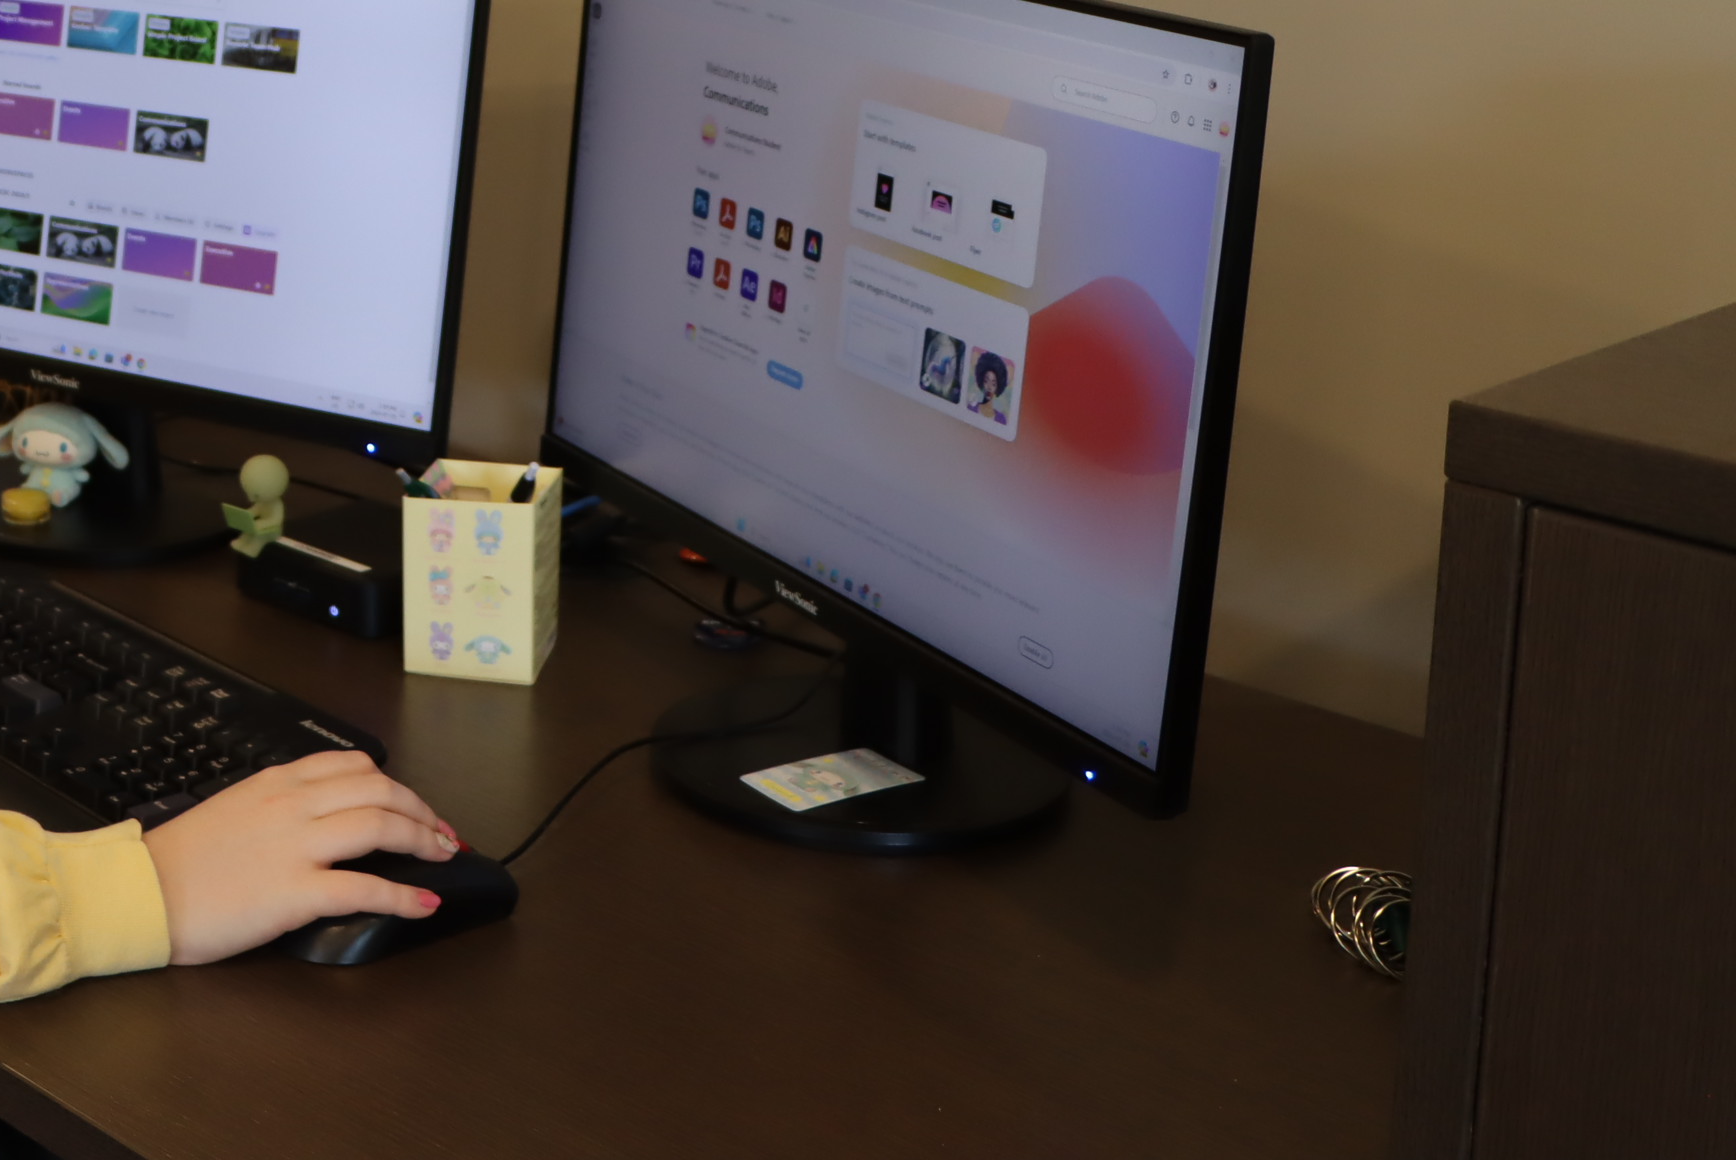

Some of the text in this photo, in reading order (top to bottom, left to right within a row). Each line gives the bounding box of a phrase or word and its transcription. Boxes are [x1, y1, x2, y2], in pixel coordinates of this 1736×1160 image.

[703, 86, 769, 116] Communications
[30, 368, 81, 390] ViewSonic
[774, 579, 819, 617] ViewSonic
[298, 719, 355, 748] lenovo
